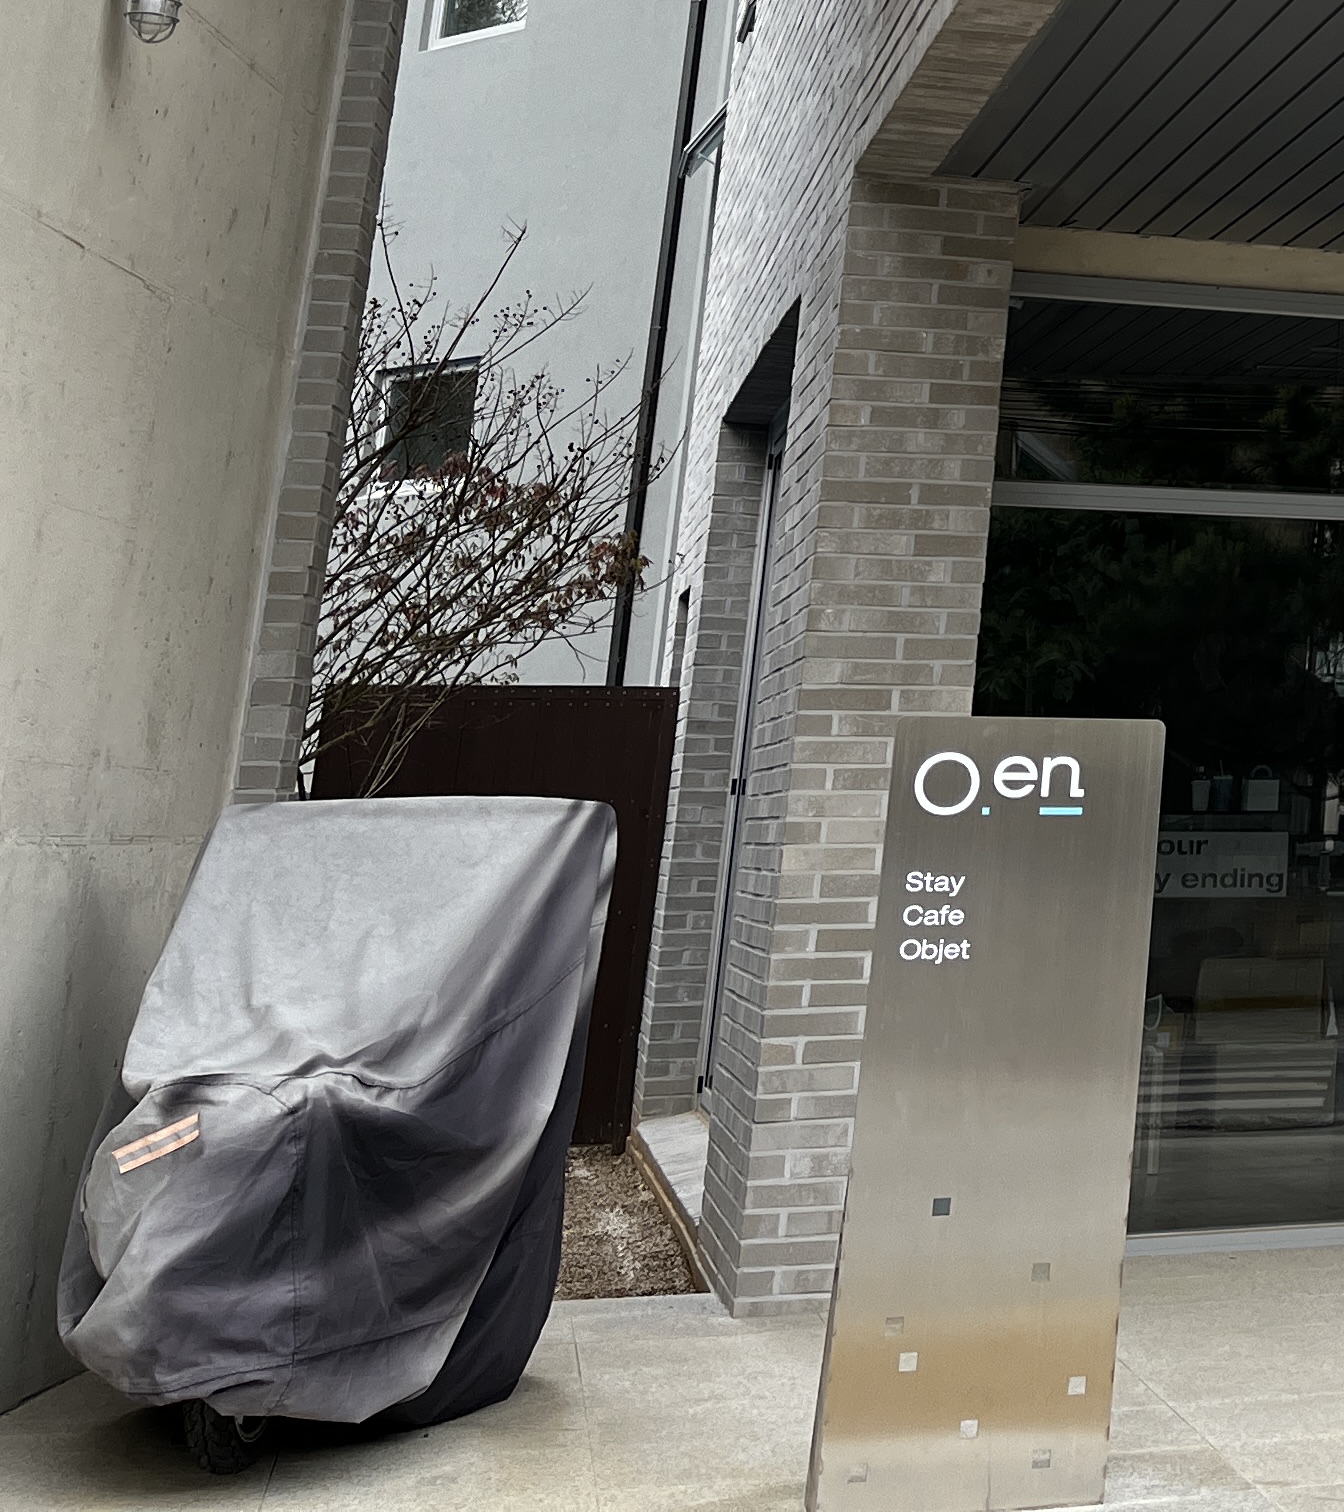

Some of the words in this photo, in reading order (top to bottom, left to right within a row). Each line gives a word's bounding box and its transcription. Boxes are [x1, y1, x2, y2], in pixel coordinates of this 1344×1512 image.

[905, 870, 966, 897] Stay
[1180, 867, 1285, 894] ending
[902, 904, 965, 927] Cafe
[899, 938, 971, 965] Objet
